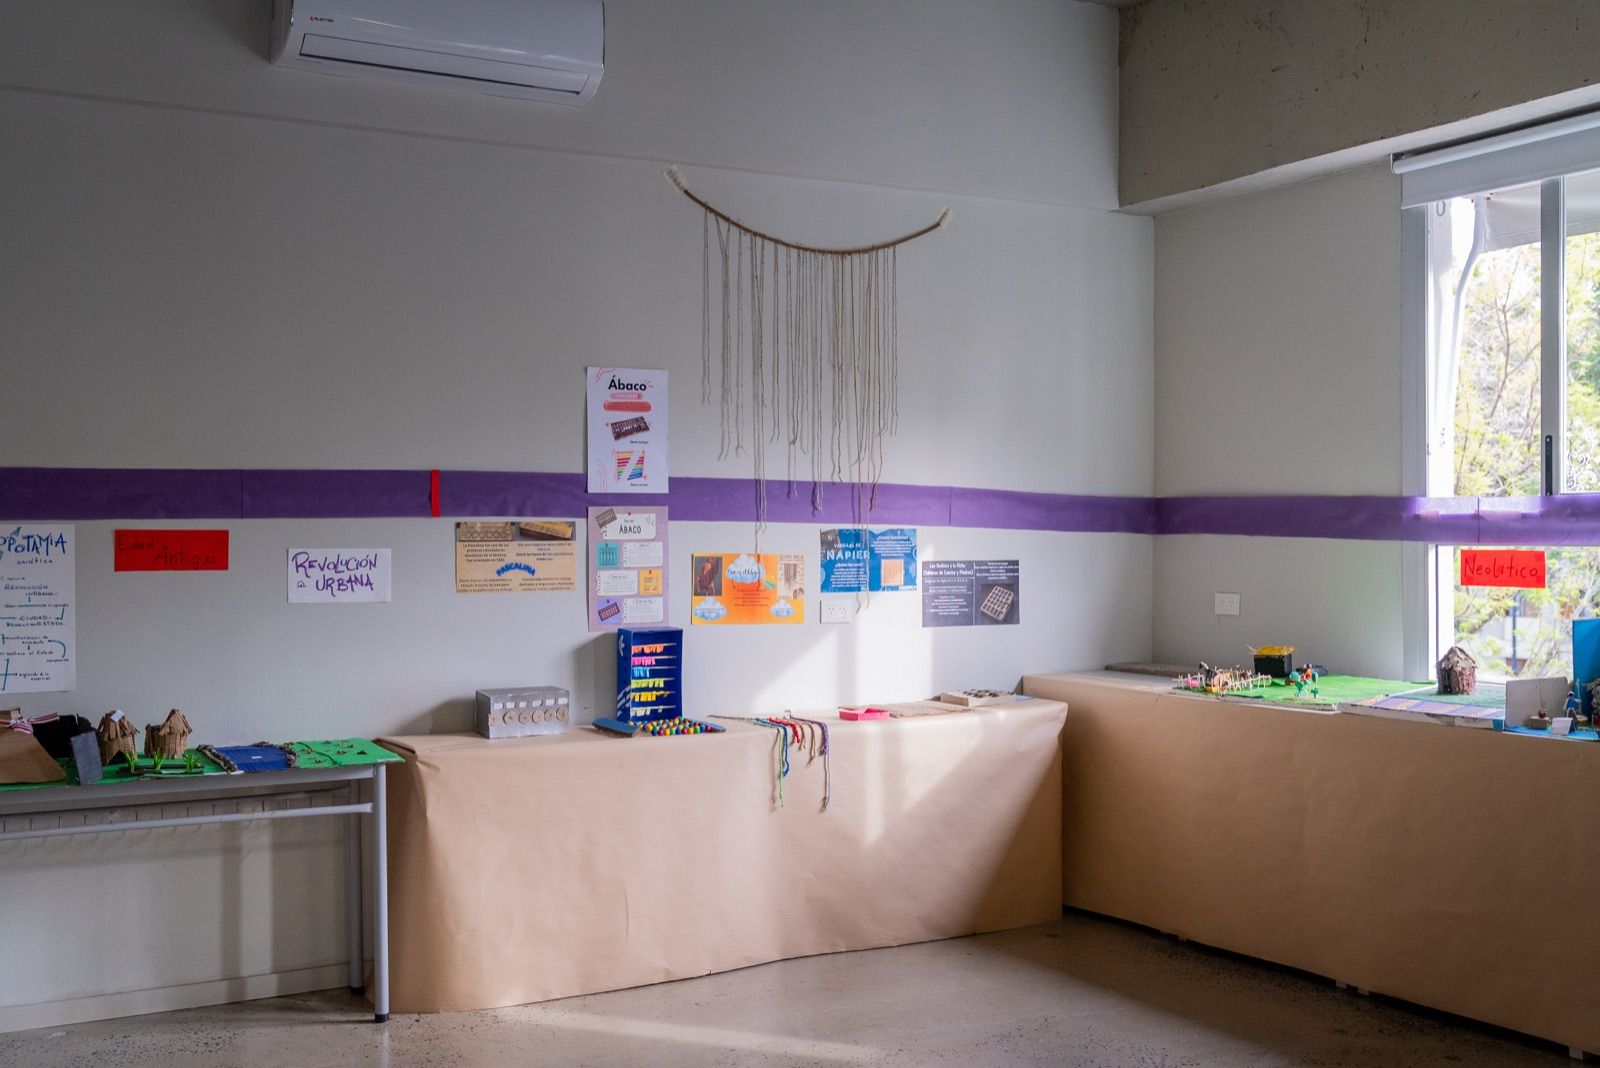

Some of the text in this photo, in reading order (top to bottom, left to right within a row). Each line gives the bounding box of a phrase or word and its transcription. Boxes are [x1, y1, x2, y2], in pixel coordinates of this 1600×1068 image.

[608, 374, 647, 392] Ábaco
[118, 533, 154, 550] Edad
[826, 550, 870, 560] NAPIER
[292, 551, 378, 578] REVOLUCIÓN
[496, 562, 536, 577] PASCALINA
[316, 573, 374, 597] URBANA
